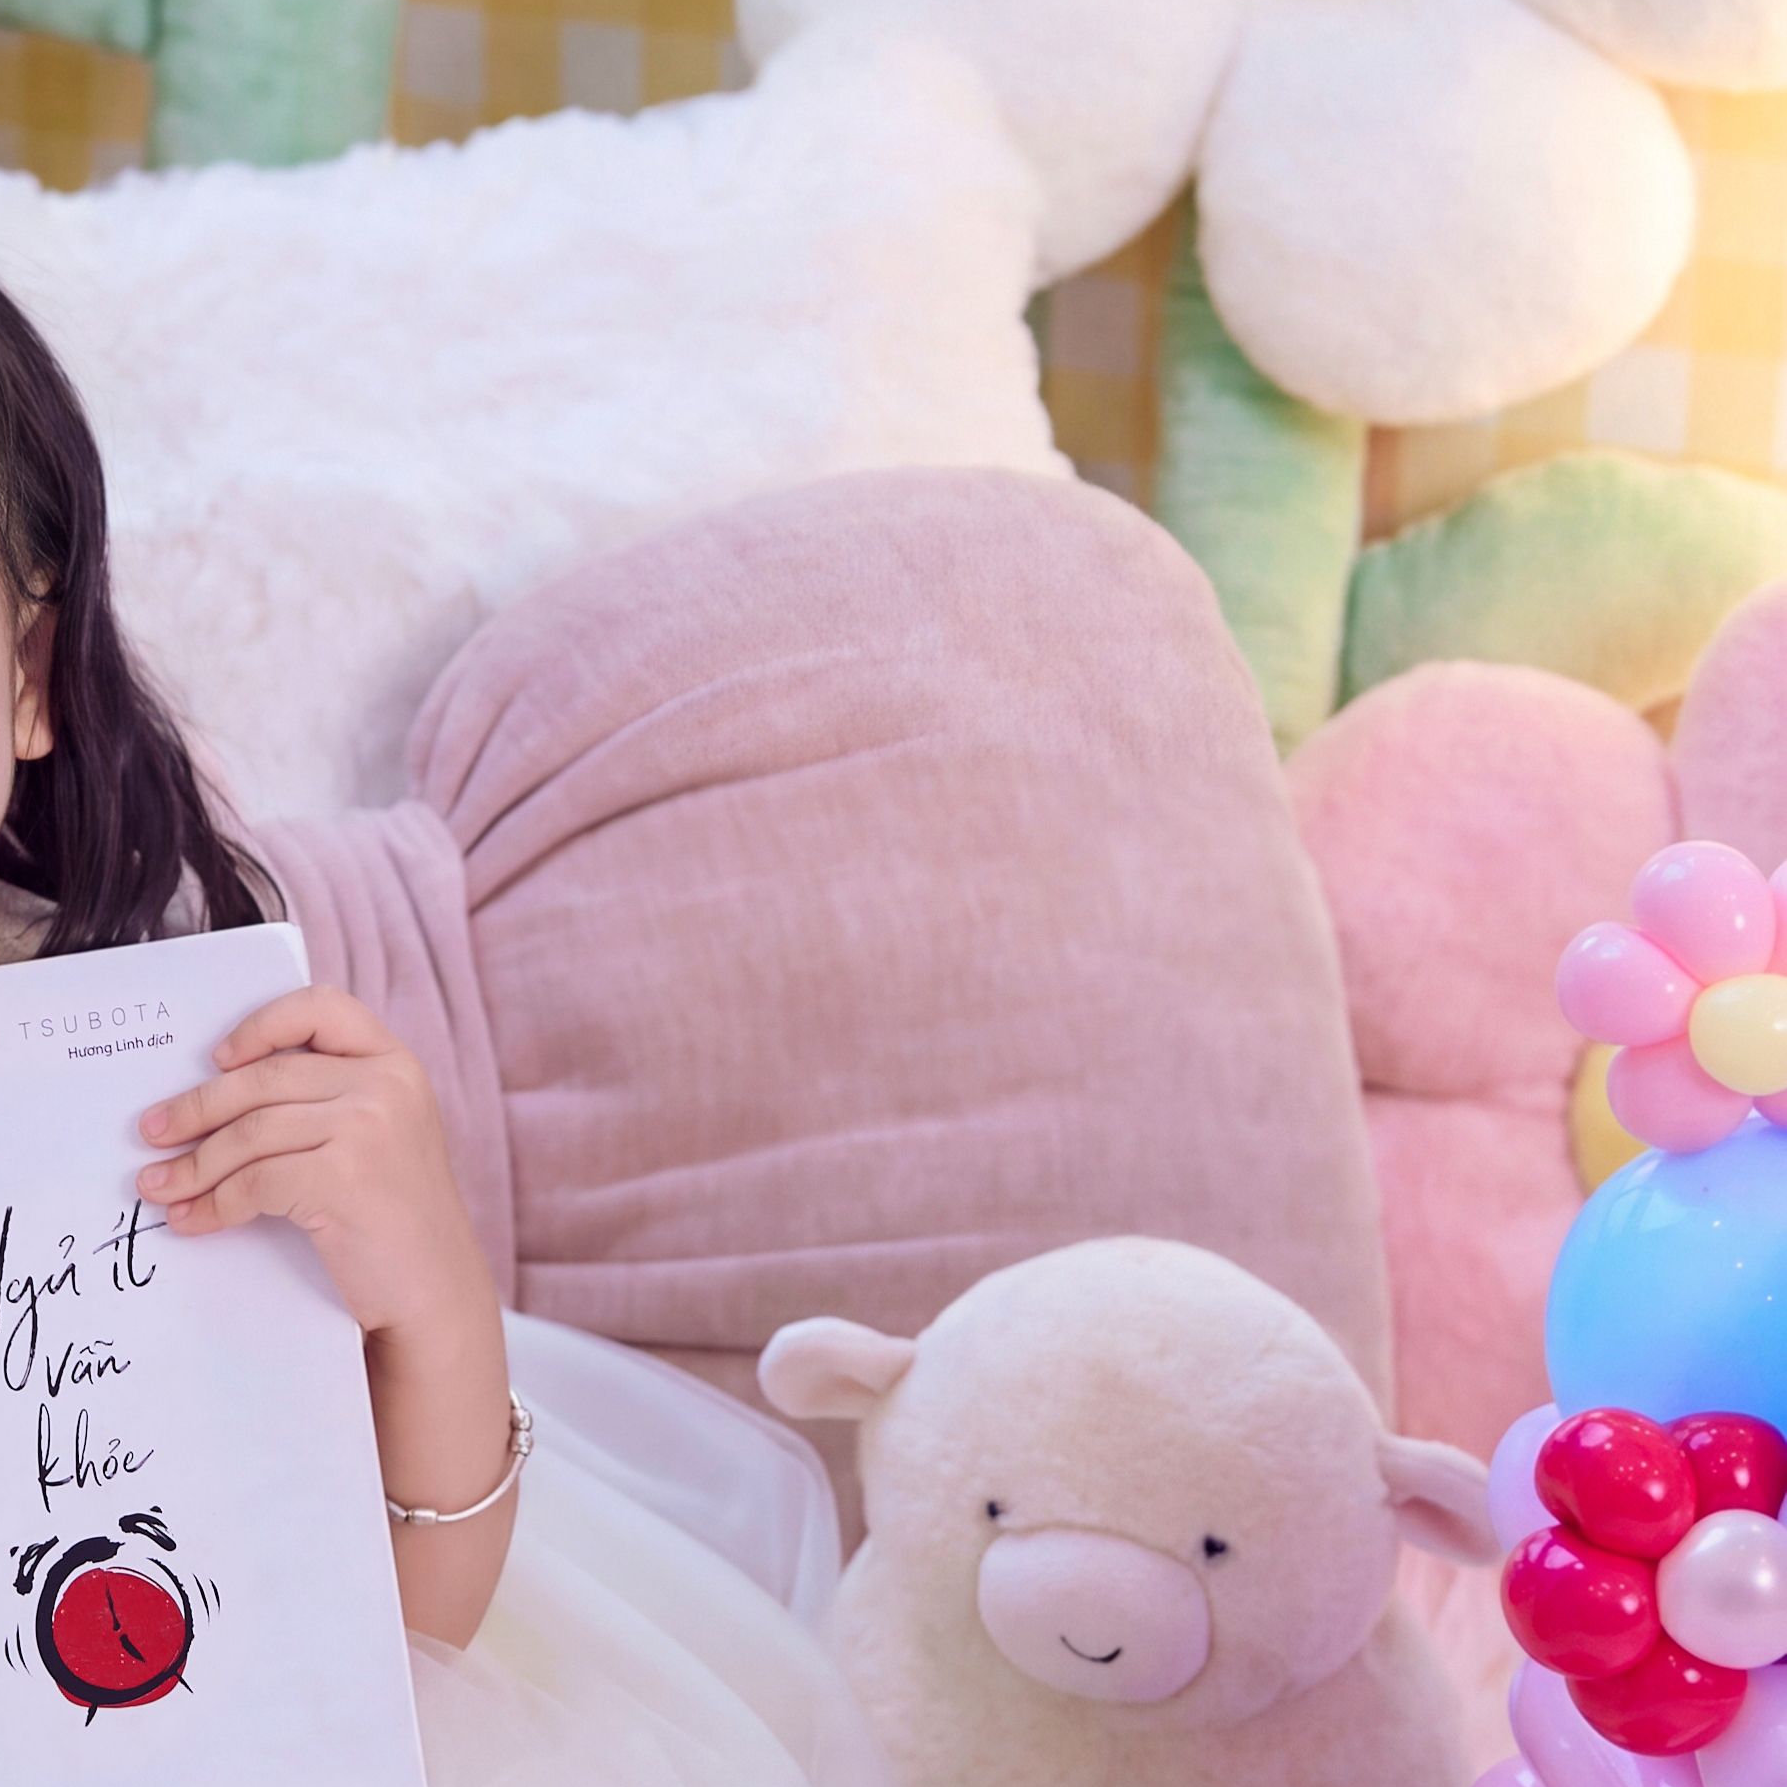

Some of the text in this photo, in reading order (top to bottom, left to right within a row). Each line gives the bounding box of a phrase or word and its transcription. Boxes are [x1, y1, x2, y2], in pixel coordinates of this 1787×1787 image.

[17, 1000, 172, 1041] TSUBOTA
[67, 1032, 175, 1061] Hương Linh dịch
[92, 1197, 169, 1293] ít
[36, 1401, 155, 1515] khỏe
